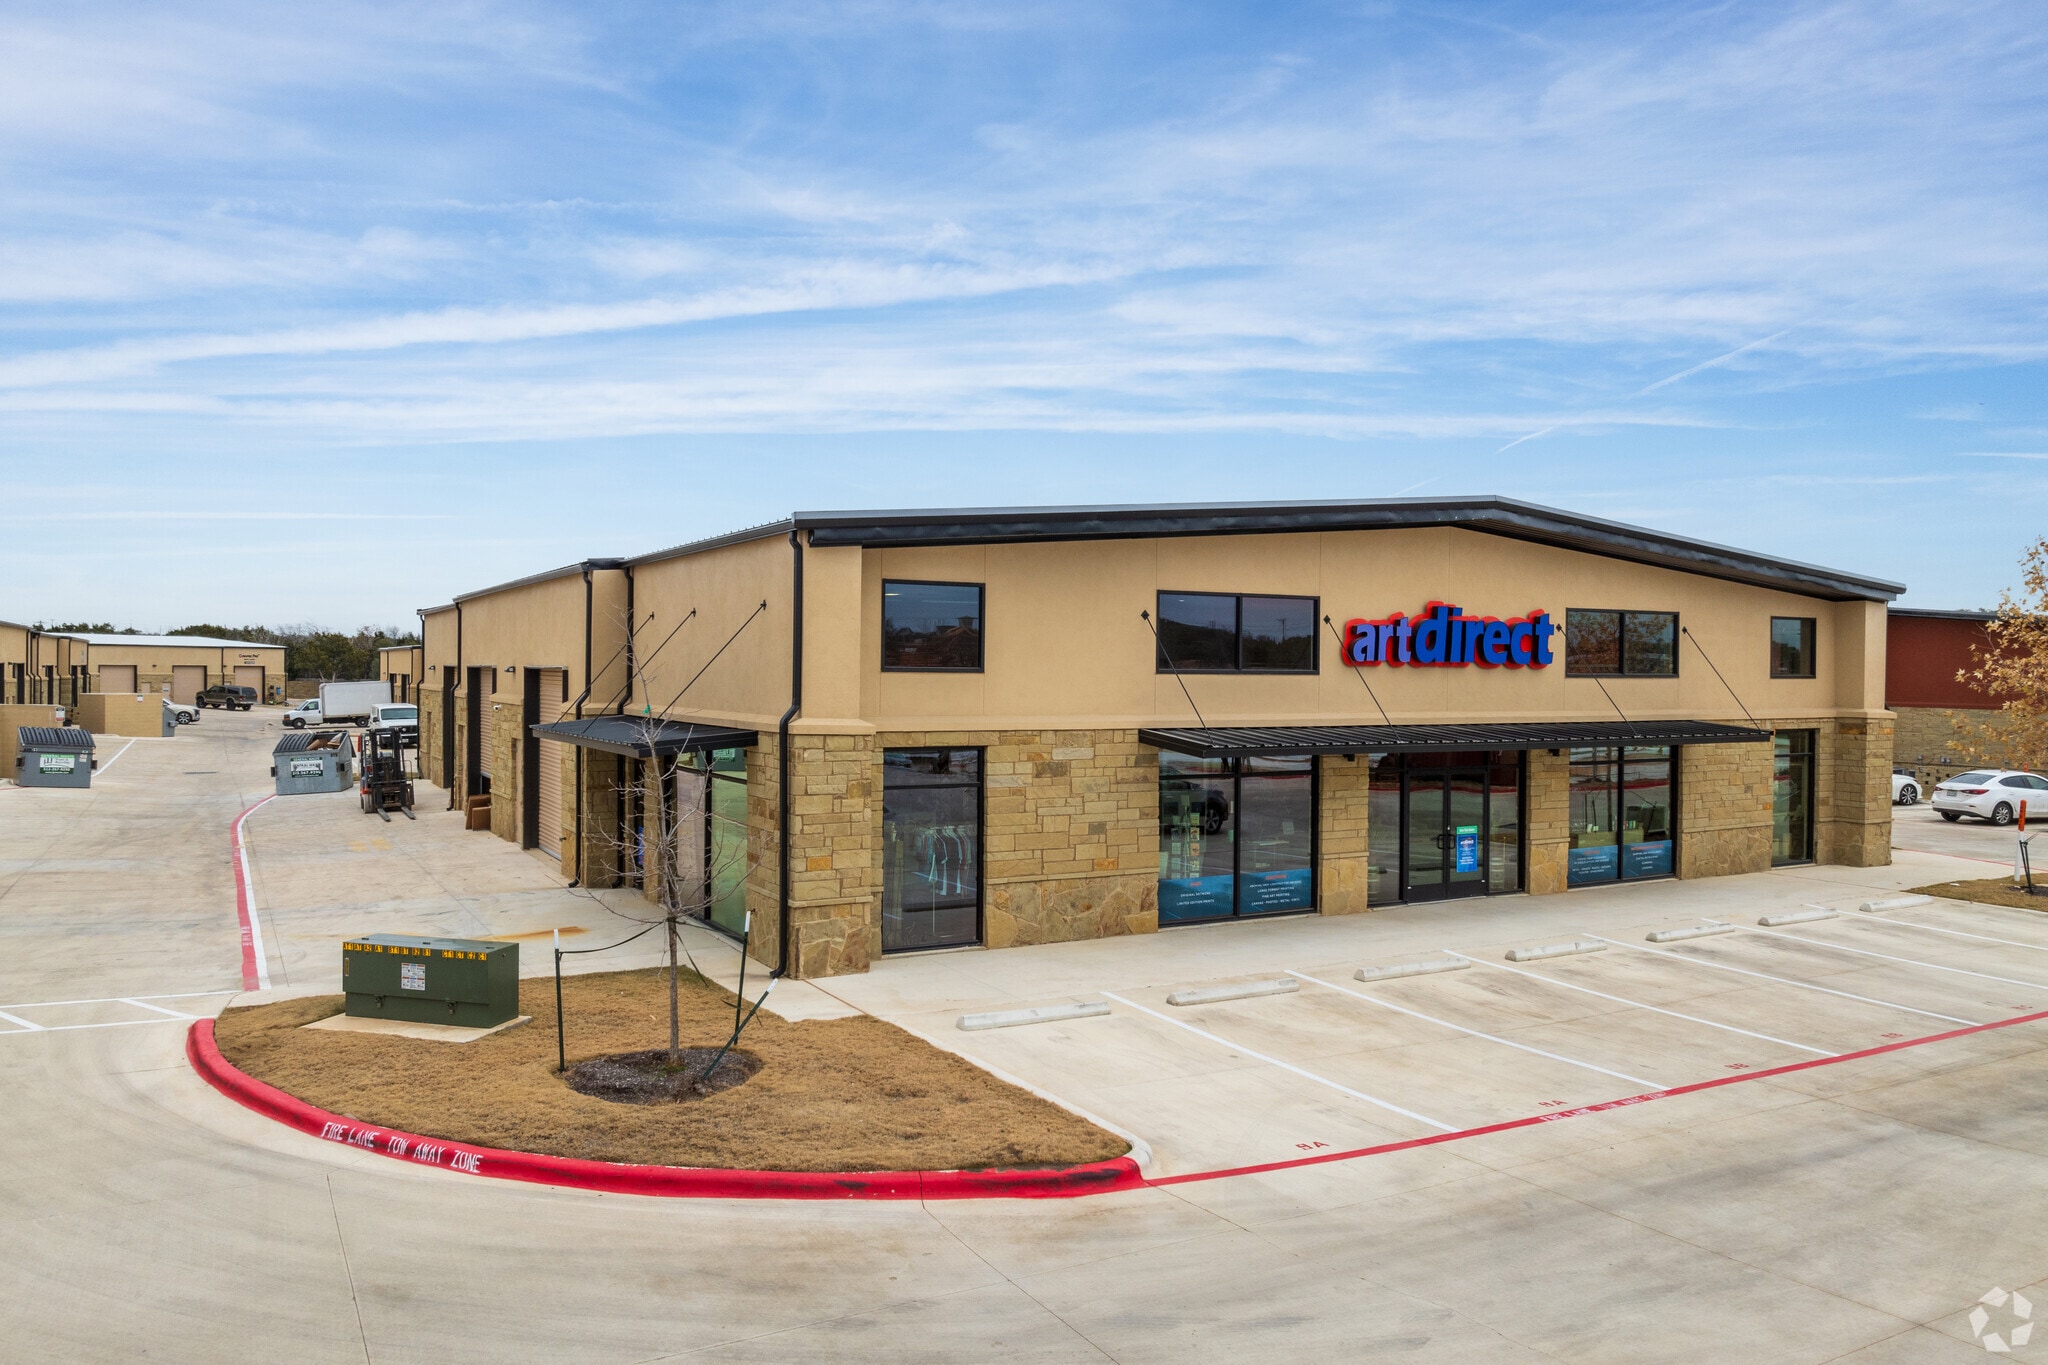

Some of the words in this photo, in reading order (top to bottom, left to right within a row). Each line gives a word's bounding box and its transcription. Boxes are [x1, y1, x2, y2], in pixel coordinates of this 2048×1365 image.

[320, 1121, 348, 1141] FIRE
[347, 1127, 380, 1148] LANE
[387, 1135, 411, 1156] TOW
[414, 1142, 446, 1164] AWAY
[450, 1149, 483, 1174] ZONE
